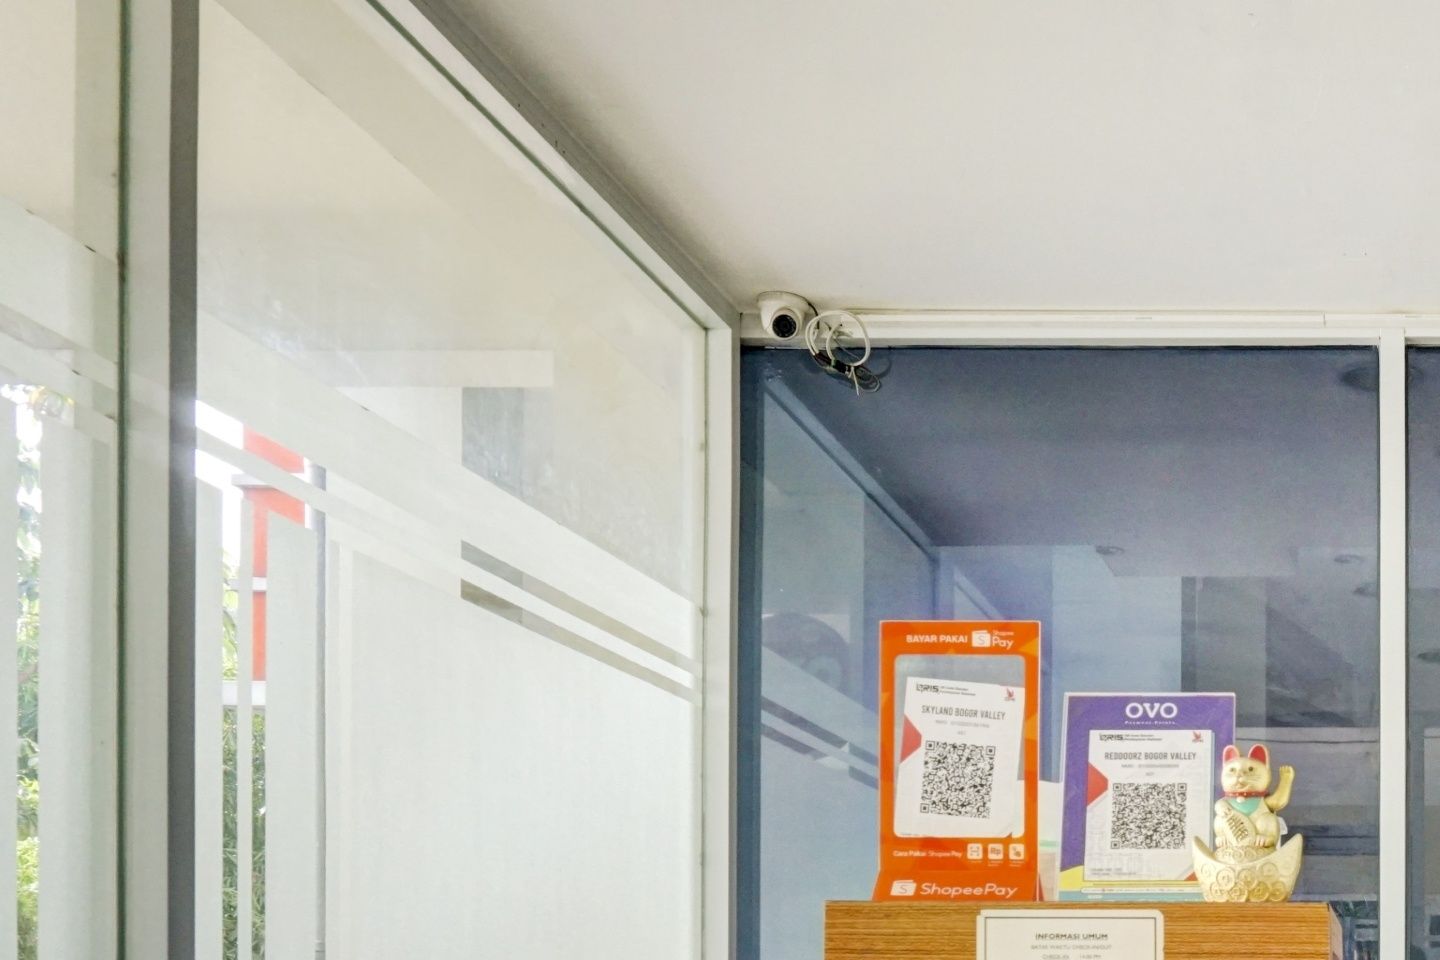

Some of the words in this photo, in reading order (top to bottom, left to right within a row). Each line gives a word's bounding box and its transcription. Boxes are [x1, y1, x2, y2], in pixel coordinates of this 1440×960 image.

[906, 634, 938, 644] BAYAR
[939, 634, 968, 644] PAKAI
[992, 636, 1013, 650] Pay
[921, 704, 953, 716] SKYLAND
[954, 706, 978, 718] BOGOR
[980, 708, 1006, 720] VALLEY
[1125, 702, 1178, 719] OVO
[1144, 751, 1168, 761] BOGOR
[1171, 751, 1197, 761] VALLEY
[920, 882, 1018, 899] ShopeePay
[1035, 933, 1080, 941] INFORMASI
[1082, 933, 1108, 941] UMUM
